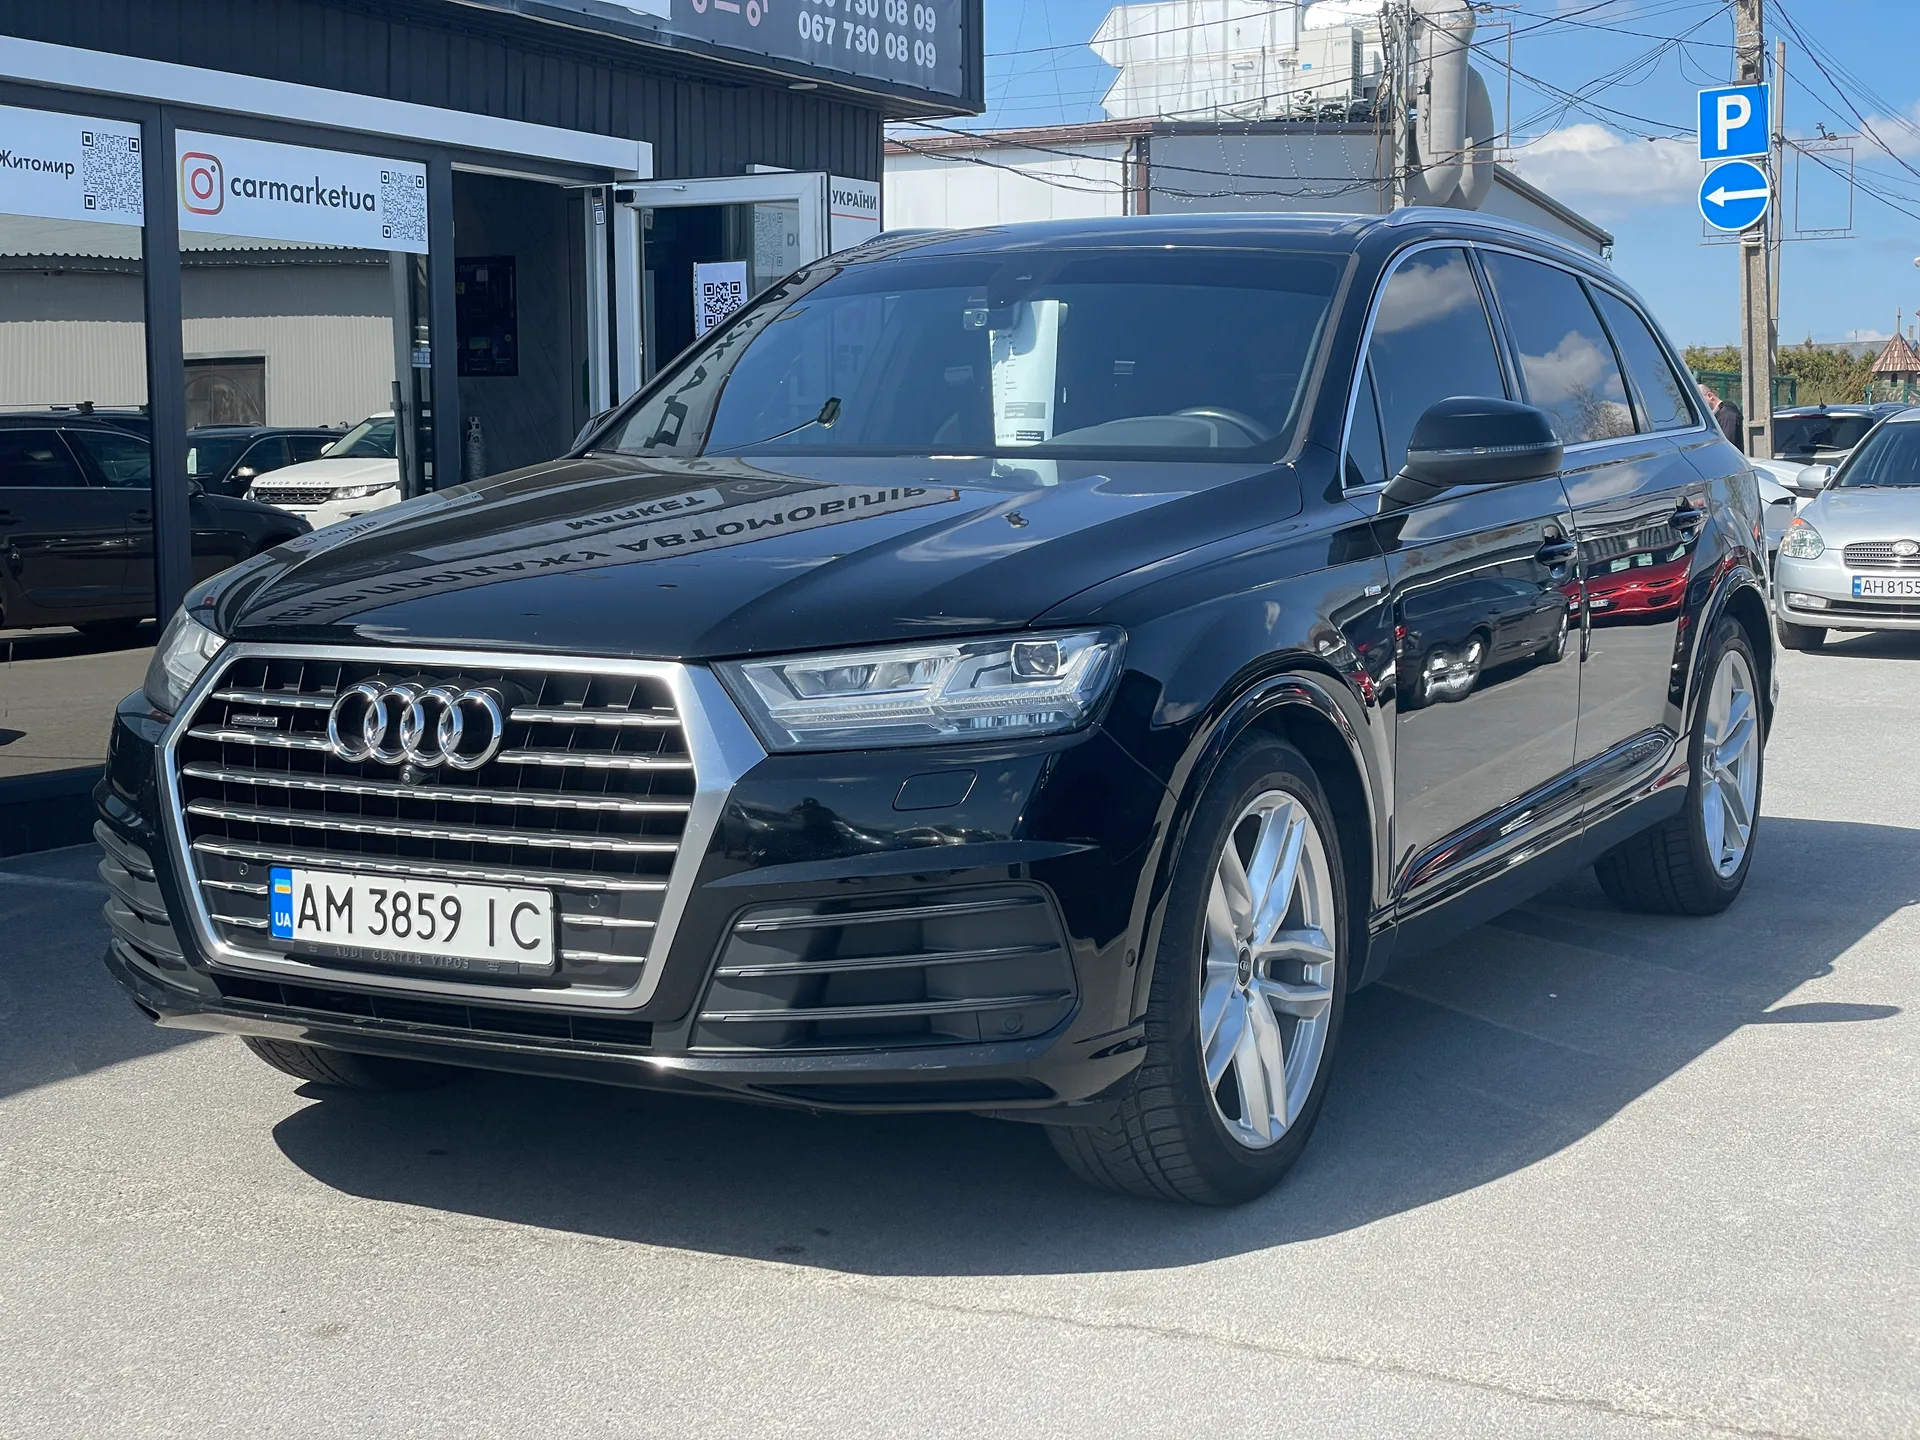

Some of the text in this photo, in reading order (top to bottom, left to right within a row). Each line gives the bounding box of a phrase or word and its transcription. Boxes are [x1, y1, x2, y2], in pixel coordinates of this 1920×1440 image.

[885, 0, 908, 26] 08
[913, 3, 936, 33] 09
[798, 10, 937, 69] 067 730 08 09
[1717, 94, 1751, 151] P
[0, 149, 75, 179] Житомир
[230, 176, 376, 212] carmarketua
[832, 190, 877, 210] УКРАЇНИ
[1863, 580, 1884, 593] AH
[275, 911, 292, 927] UA
[297, 883, 541, 950] AM 3859 IC
[335, 946, 470, 970] AUDI CENTER VIPOS
